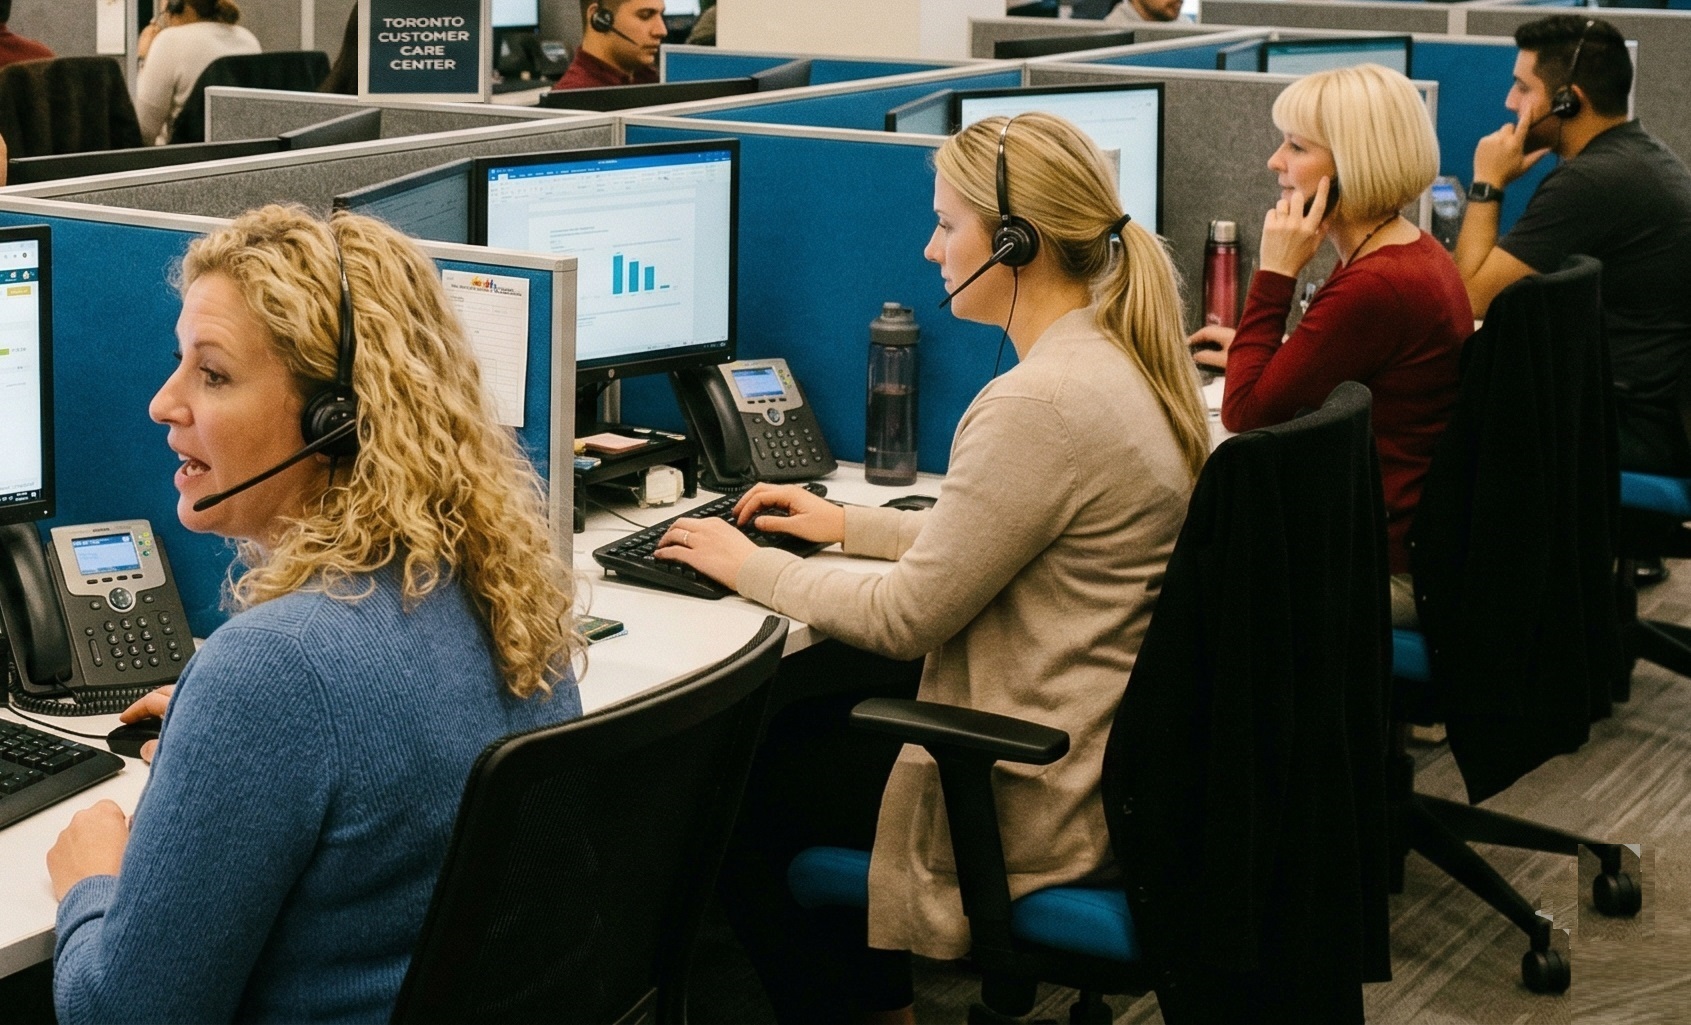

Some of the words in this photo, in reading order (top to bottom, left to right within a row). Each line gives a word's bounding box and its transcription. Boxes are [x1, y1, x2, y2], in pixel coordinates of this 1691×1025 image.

[382, 16, 465, 28] TORONTO
[377, 31, 470, 42] CUSTOMER
[400, 45, 446, 56] CARE
[390, 59, 456, 70] CENTER
